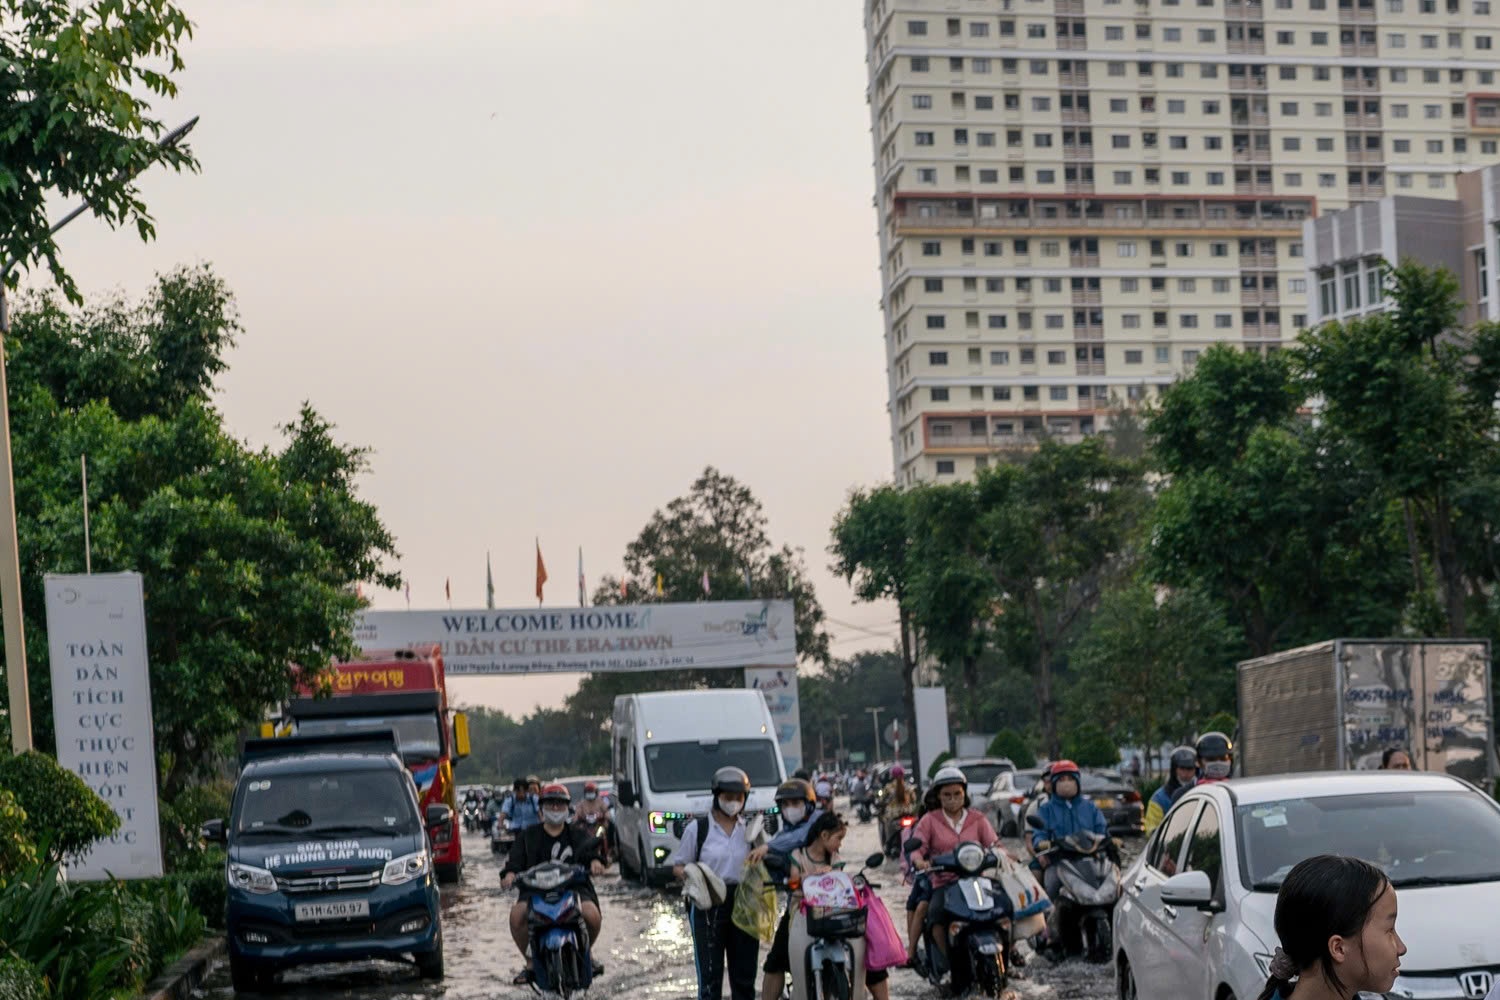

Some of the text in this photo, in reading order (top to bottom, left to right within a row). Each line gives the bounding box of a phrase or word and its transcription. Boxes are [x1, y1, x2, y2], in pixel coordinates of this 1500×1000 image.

[442, 611, 638, 633] WELCOME HOME
[66, 640, 124, 657] TOÀN
[454, 636, 495, 657] DÂN
[532, 638, 570, 654] THE
[576, 636, 614, 653] ERA
[616, 634, 673, 652] TOWN
[76, 663, 118, 681] DÂN
[72, 687, 124, 705] TÍCH
[78, 712, 122, 731] CỰC
[76, 736, 135, 754] THỰC
[78, 760, 129, 778] HIỆN
[264, 854, 281, 870] HỆ
